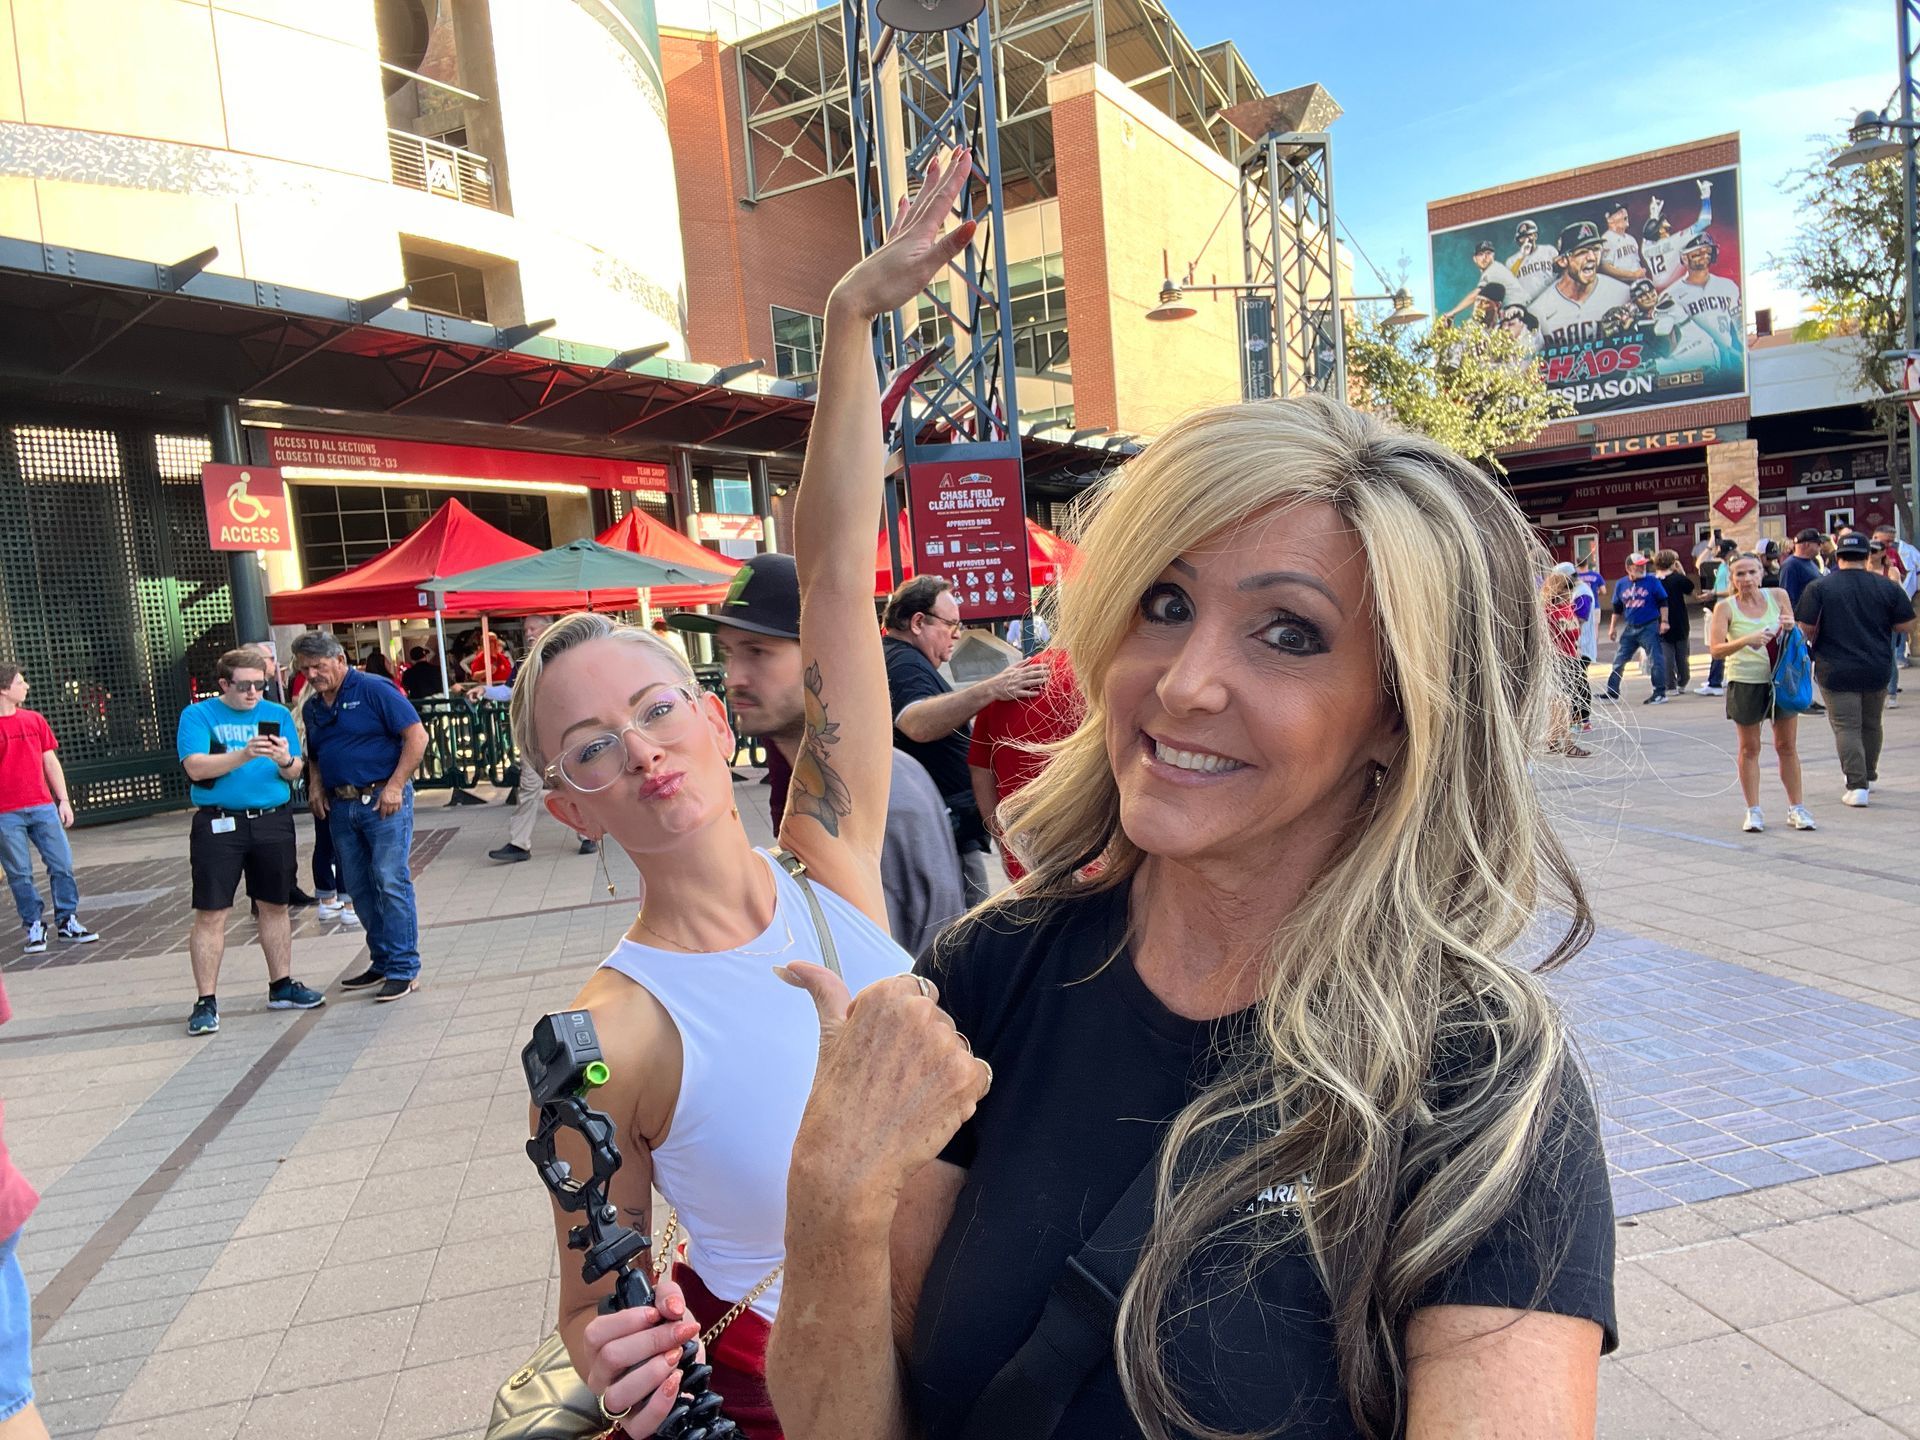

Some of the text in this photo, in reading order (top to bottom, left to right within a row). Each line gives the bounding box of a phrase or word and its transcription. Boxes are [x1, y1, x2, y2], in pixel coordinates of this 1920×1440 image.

[1649, 255, 1666, 275] 12
[1612, 333, 1644, 346] THE
[273, 436, 376, 454] ACCESS TO ALL SECTIONS
[1595, 429, 1717, 454] TICKETS
[275, 451, 312, 463] CLOSEST
[313, 454, 326, 464] TO
[327, 455, 366, 466] SECTIONS
[1761, 464, 1785, 476] IELD
[1800, 468, 1843, 483] 2023
[1575, 488, 1600, 498] HOST
[1604, 485, 1631, 494] YOUR
[1634, 481, 1661, 491] NEXT
[1664, 475, 1697, 487] EVENT
[940, 488, 993, 501] CHASE FIELD
[928, 497, 1005, 510] CLEAR BAG POLICY
[946, 520, 975, 528] APPROVED
[976, 518, 992, 526] BAGS
[220, 526, 280, 544] ACCESS
